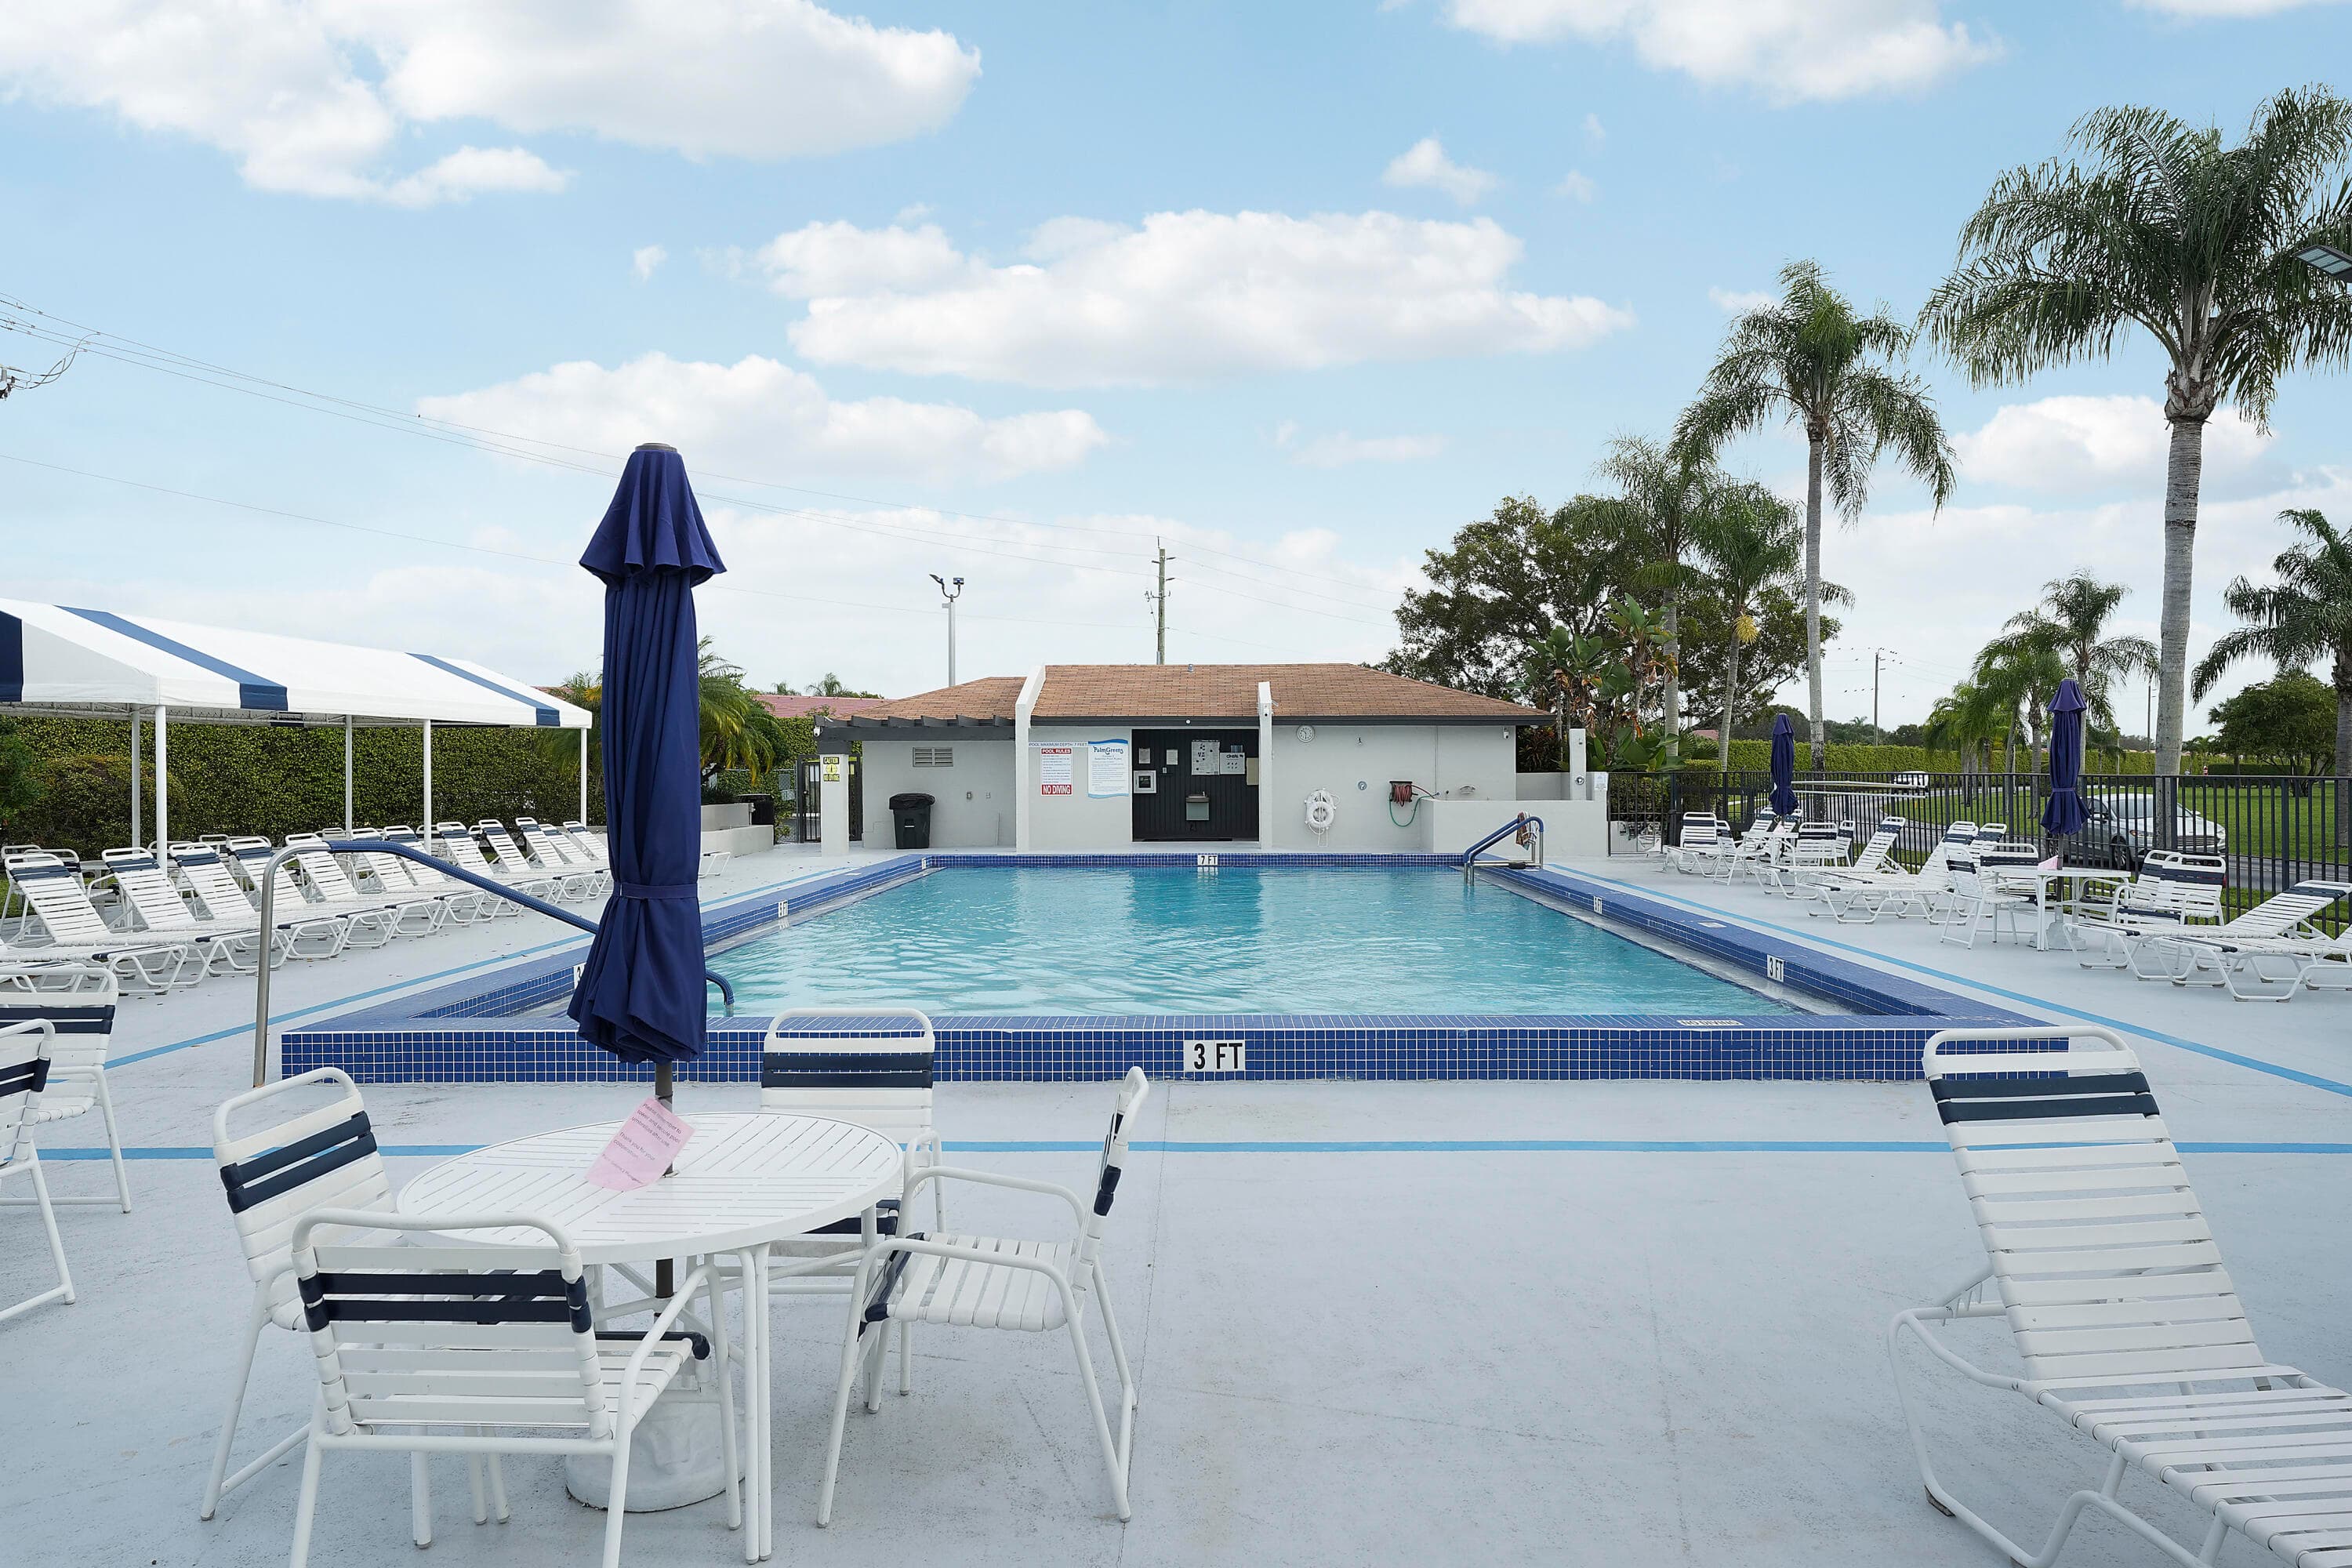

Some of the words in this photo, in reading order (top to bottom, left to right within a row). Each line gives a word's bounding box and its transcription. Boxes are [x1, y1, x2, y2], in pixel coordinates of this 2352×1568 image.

[1043, 785, 1051, 794] NO
[1052, 785, 1071, 794] DIVING
[1201, 855, 1205, 864] 7
[1208, 855, 1217, 864] FT
[1769, 957, 1773, 976] 3
[1775, 959, 1783, 980] FT
[1193, 1043, 1206, 1070] 3
[1216, 1043, 1243, 1069] FT
[643, 1103, 657, 1115] Please
[637, 1109, 651, 1120] lower
[648, 1118, 659, 1127] and
[657, 1124, 671, 1136] secure
[669, 1134, 681, 1145] pool
[652, 1131, 662, 1141] after
[619, 1131, 633, 1143] Thank
[630, 1142, 641, 1150] you
[644, 1152, 656, 1161] your
